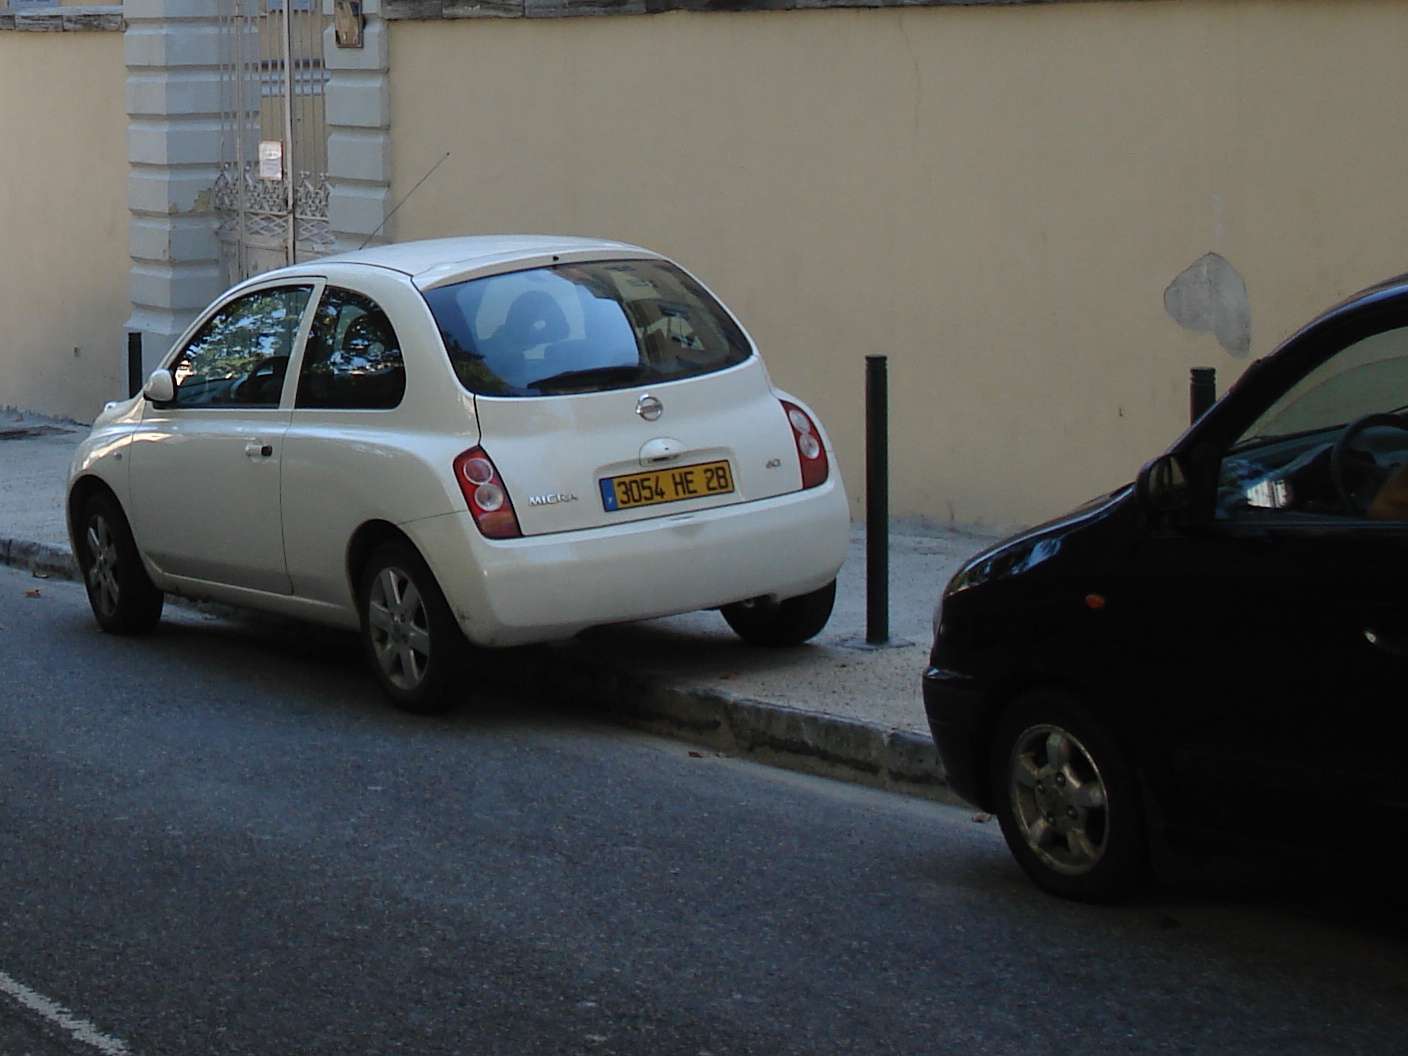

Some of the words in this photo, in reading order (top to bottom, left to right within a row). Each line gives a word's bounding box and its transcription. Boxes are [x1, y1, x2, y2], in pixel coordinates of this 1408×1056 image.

[616, 475, 665, 504] 3054
[672, 471, 698, 496] HE
[703, 466, 729, 490] 2B
[528, 493, 578, 506] MICRA
